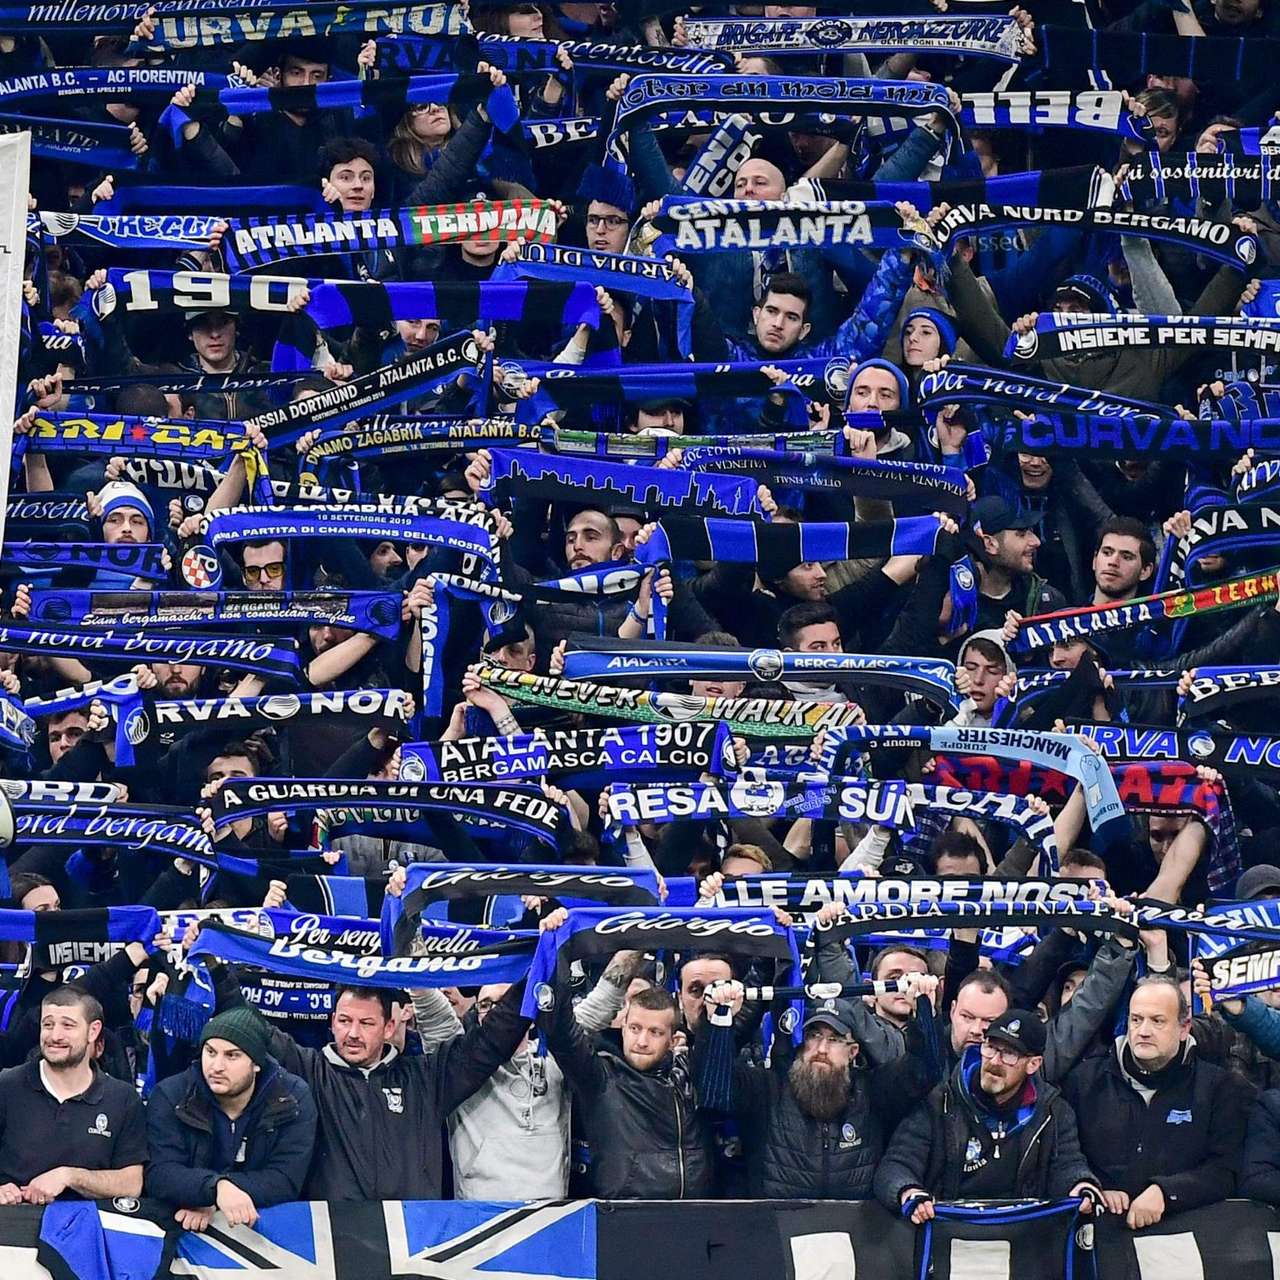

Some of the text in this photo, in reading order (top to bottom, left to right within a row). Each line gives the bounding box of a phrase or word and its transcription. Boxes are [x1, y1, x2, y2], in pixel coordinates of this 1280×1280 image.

[234, 205, 558, 255] ATALANTA TERNANA
[676, 216, 874, 248] ATALANTA
[1057, 327, 1208, 353] INSIEME PER
[290, 356, 435, 422] DORTMUND ATALANTA
[1026, 609, 1152, 649] ATALANTA
[440, 723, 711, 768] ATALANTA 1907
[612, 748, 709, 768] CALCIO
[806, 879, 970, 906] AMORE
[289, 914, 332, 947] Per
[48, 941, 127, 965] INSIEME
